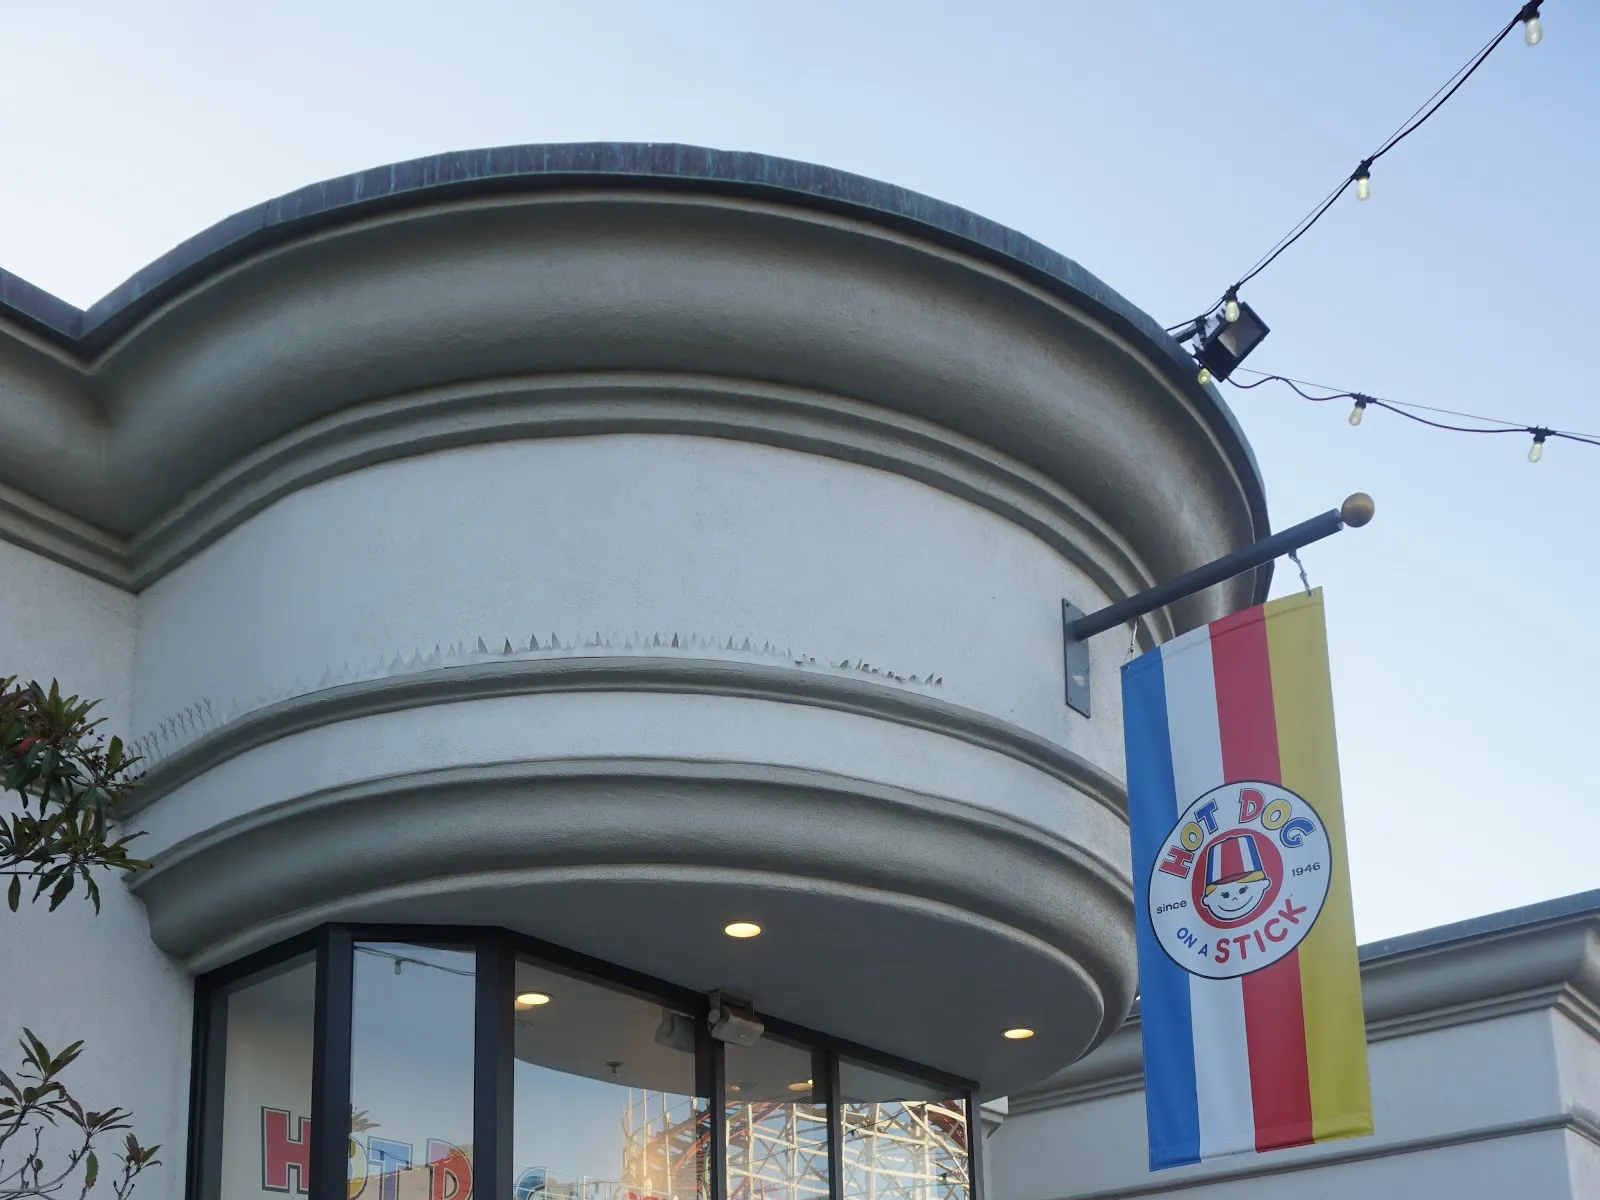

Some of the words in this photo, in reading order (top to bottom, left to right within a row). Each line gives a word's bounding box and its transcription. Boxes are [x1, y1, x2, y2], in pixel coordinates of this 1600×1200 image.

[1158, 798, 1218, 880] HOT
[1239, 787, 1316, 849] DOG
[1156, 897, 1188, 916] since
[1291, 861, 1321, 878] 1946
[1176, 926, 1196, 950] ON
[1198, 944, 1209, 958] A
[1214, 898, 1308, 964] STICK
